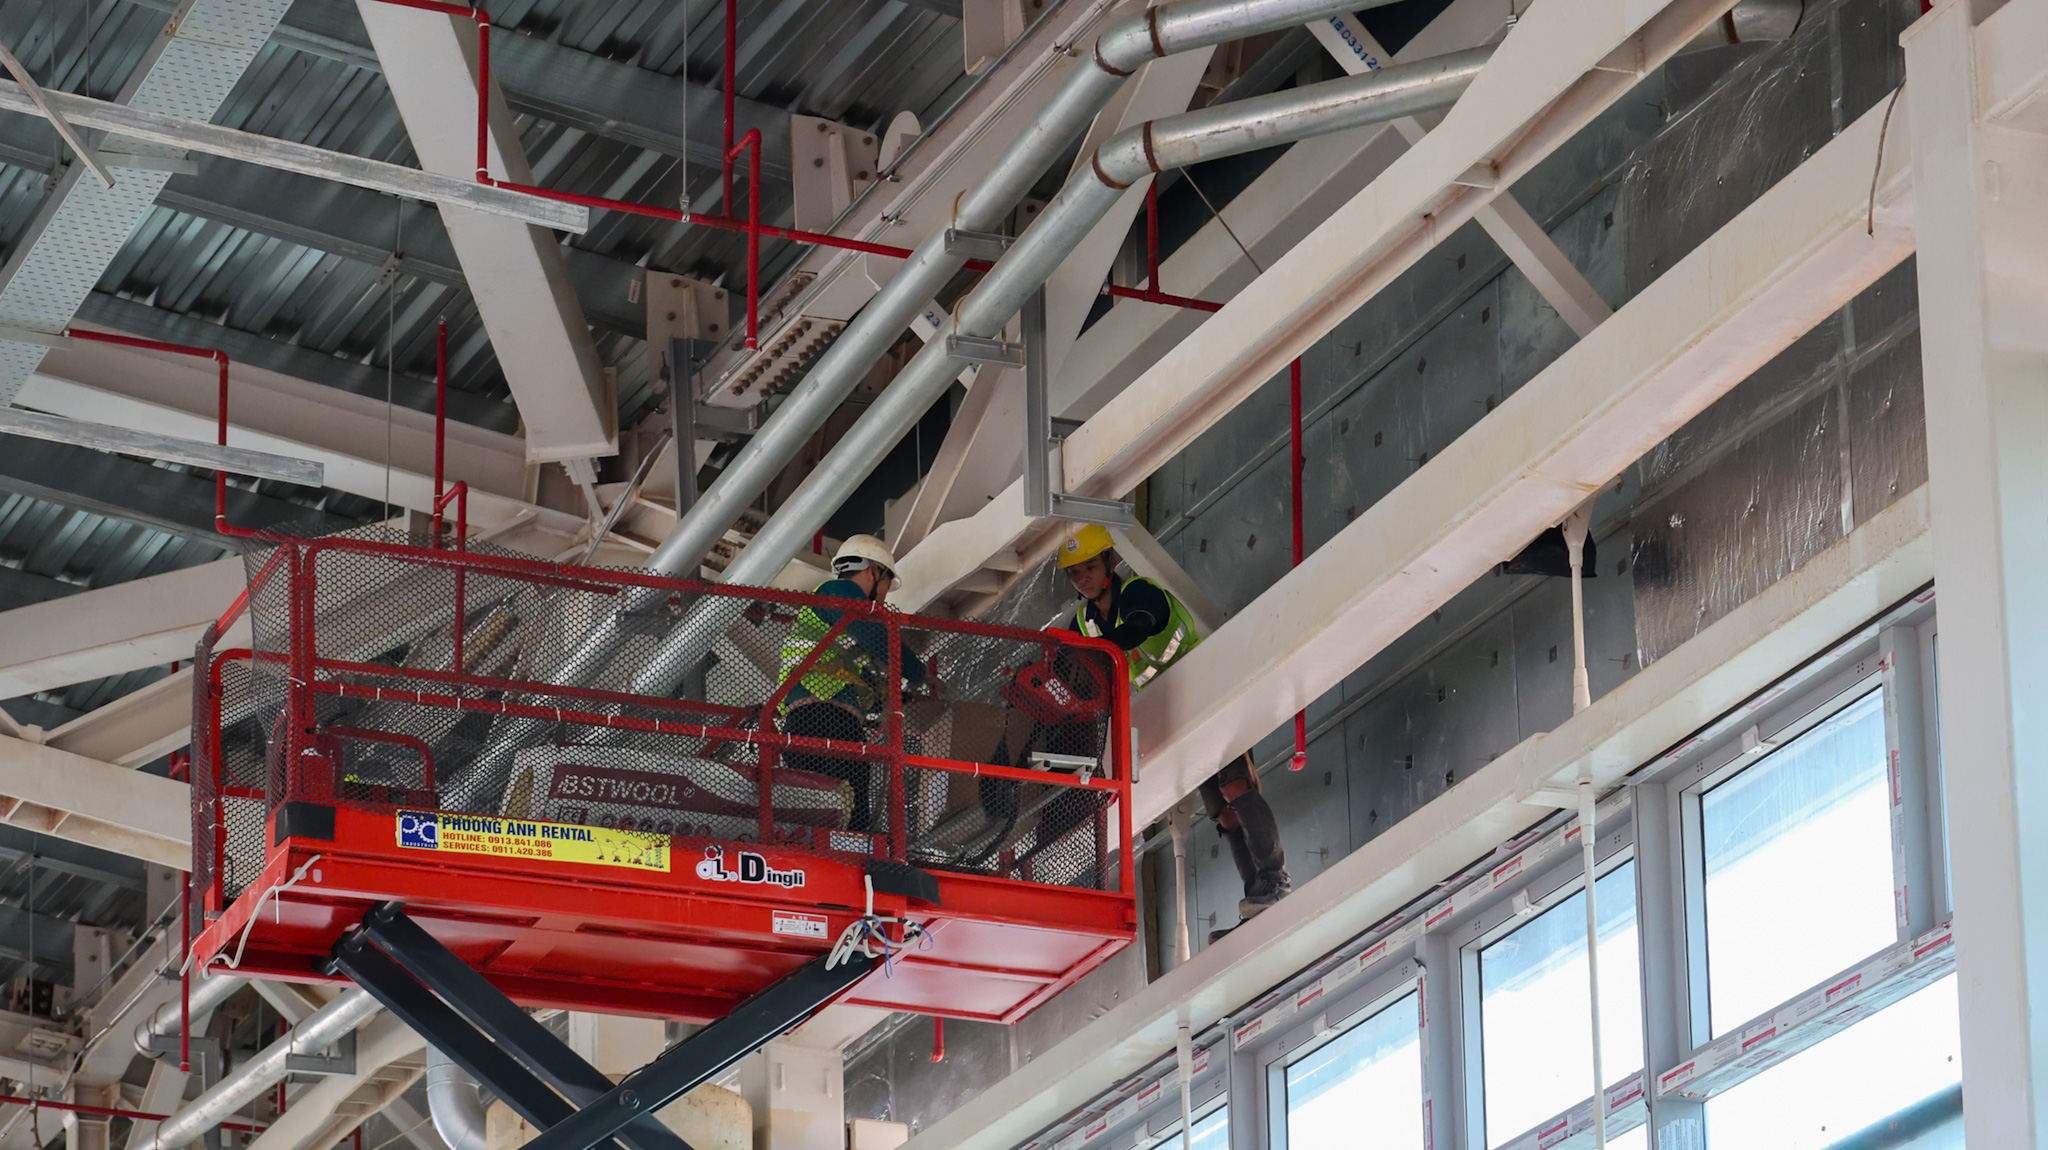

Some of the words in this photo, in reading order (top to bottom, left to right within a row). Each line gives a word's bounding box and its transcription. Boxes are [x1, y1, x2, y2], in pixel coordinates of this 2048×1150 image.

[443, 832, 486, 843] HOTLINE:
[488, 836, 552, 848] 0913.841.086
[506, 822, 537, 838] ANH
[541, 825, 595, 842] RENTAL
[443, 841, 490, 852] SERVICES:
[493, 846, 553, 857] 0911.420.386
[740, 853, 804, 887] Dingli
